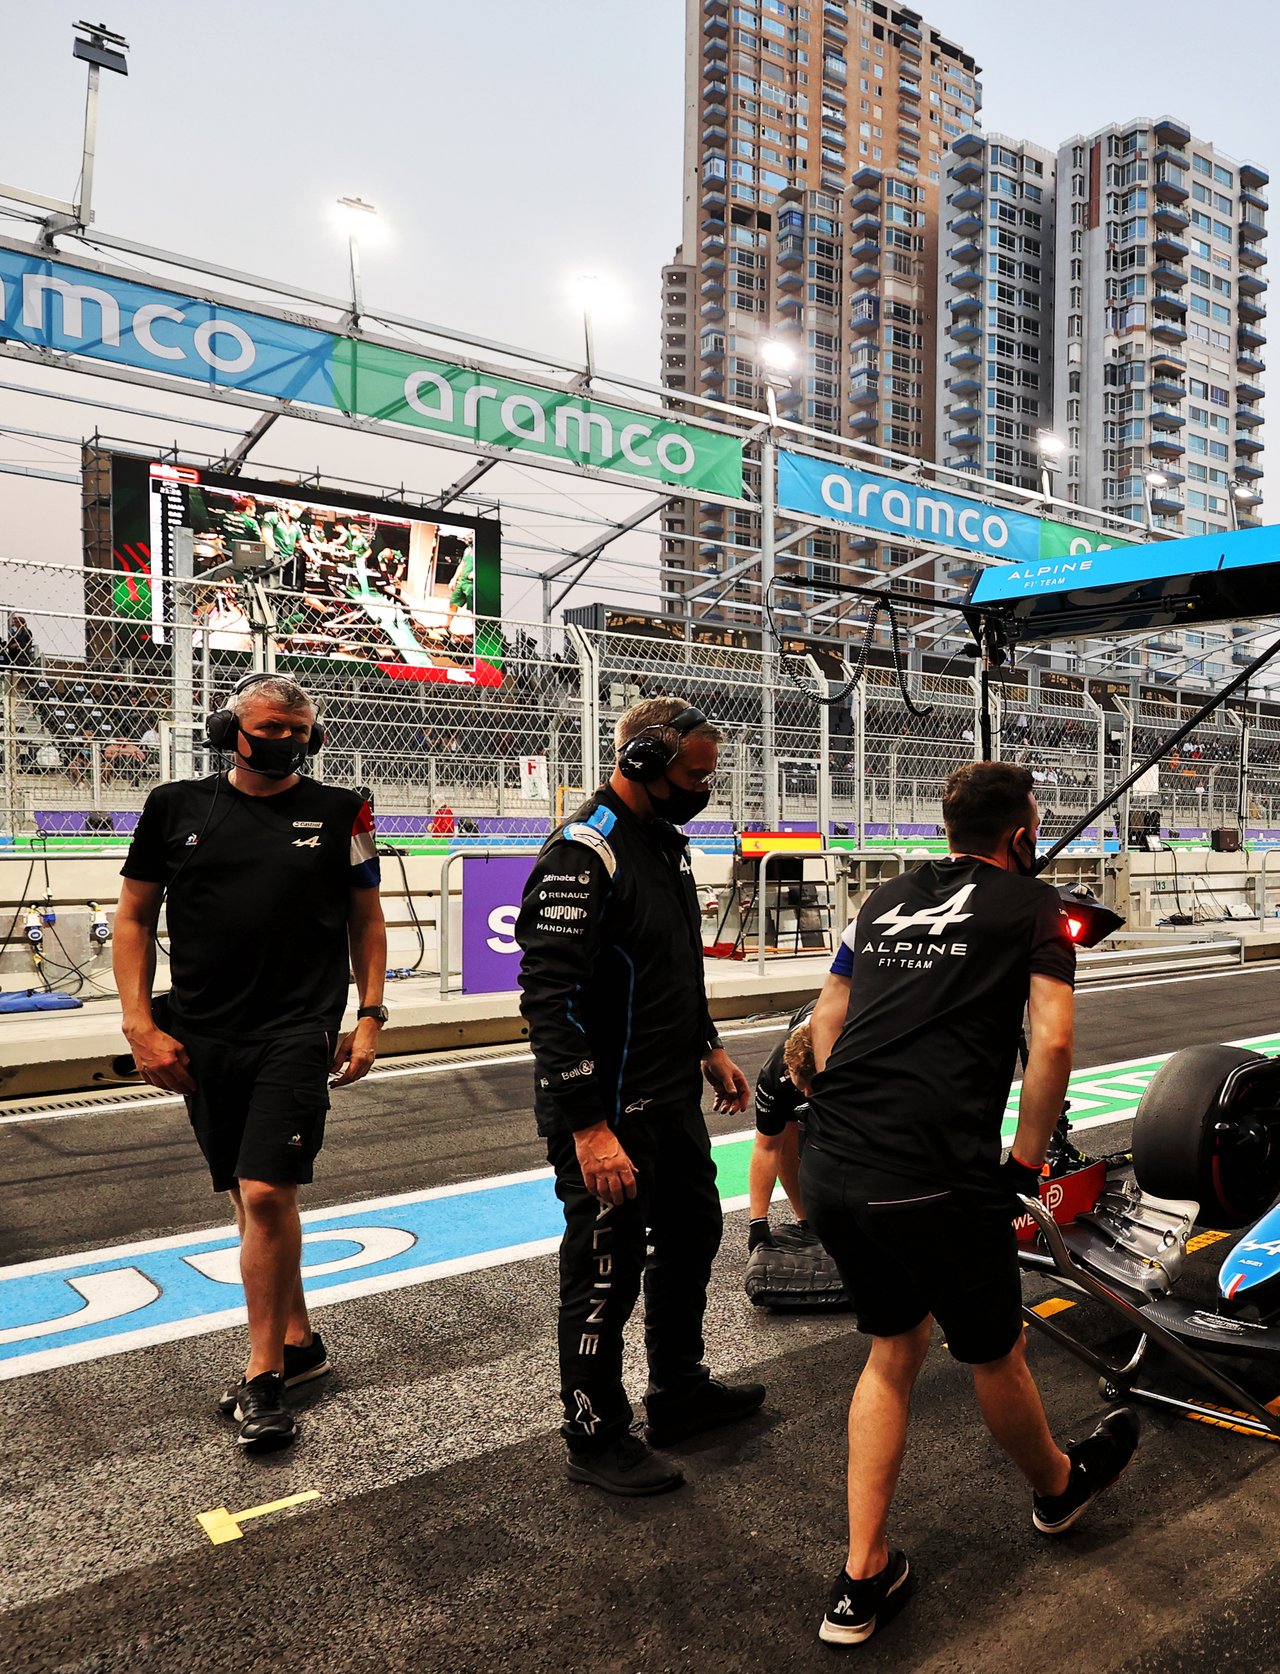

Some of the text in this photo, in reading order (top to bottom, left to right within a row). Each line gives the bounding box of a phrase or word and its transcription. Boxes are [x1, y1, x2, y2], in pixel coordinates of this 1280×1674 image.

[403, 370, 696, 475] aramco
[821, 474, 1009, 548] aramco
[1007, 560, 1093, 580] ALPINE
[1040, 577, 1066, 586] TEAM
[544, 905, 584, 920] DUPONT
[536, 923, 584, 934] MANDIANT
[861, 941, 968, 956] ALPINE
[900, 959, 933, 969] TEAM
[561, 1067, 581, 1081] Bell
[579, 1197, 615, 1355] ALPINE
